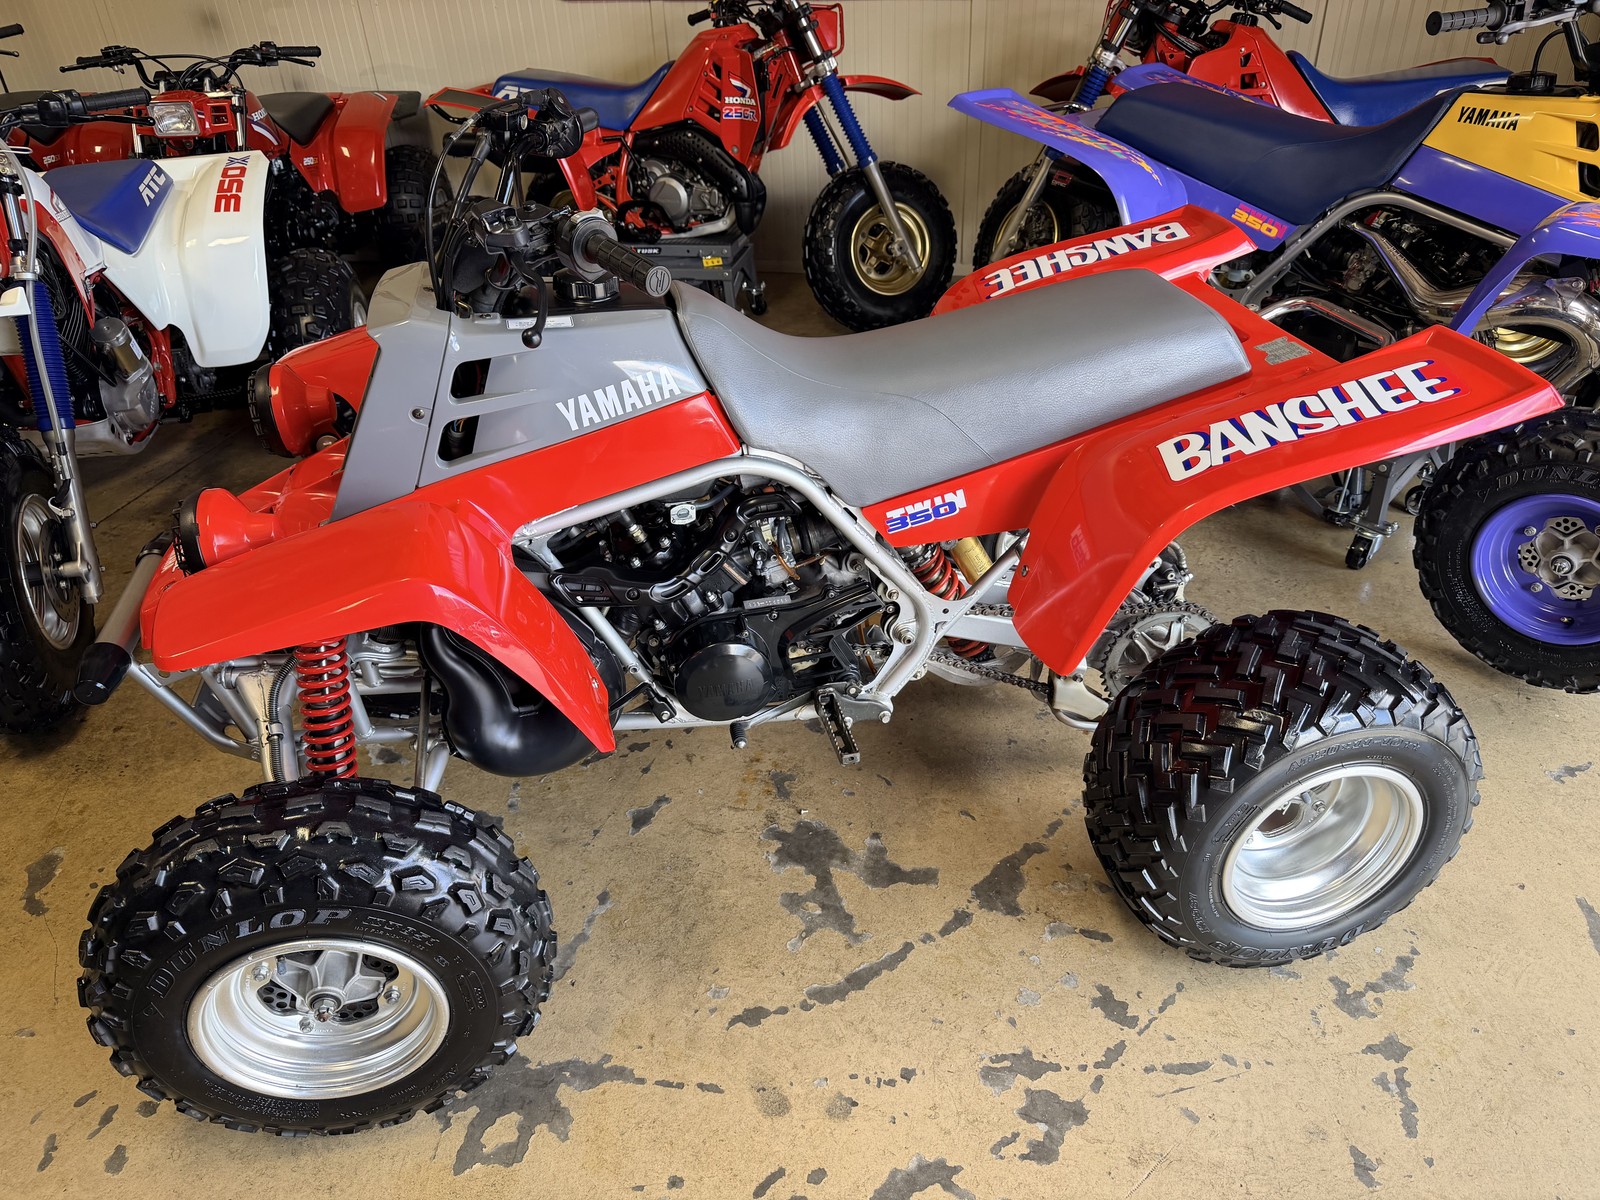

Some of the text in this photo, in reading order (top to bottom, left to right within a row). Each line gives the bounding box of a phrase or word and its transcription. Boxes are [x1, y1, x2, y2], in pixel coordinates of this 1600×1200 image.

[722, 106, 758, 122] 250R
[724, 96, 756, 106] HONDA
[1457, 105, 1521, 131] YAMAHA
[137, 165, 167, 208] ATC
[214, 155, 251, 213] 350X
[1231, 207, 1279, 239] 350
[980, 221, 1191, 300] BANSHEE
[555, 365, 682, 432] YAMAHA
[1156, 359, 1460, 482] BANSHEE
[886, 488, 967, 519] TWIN
[886, 501, 960, 534] 350
[698, 679, 753, 698] YAMAHA
[145, 908, 352, 999] DUNLOP
